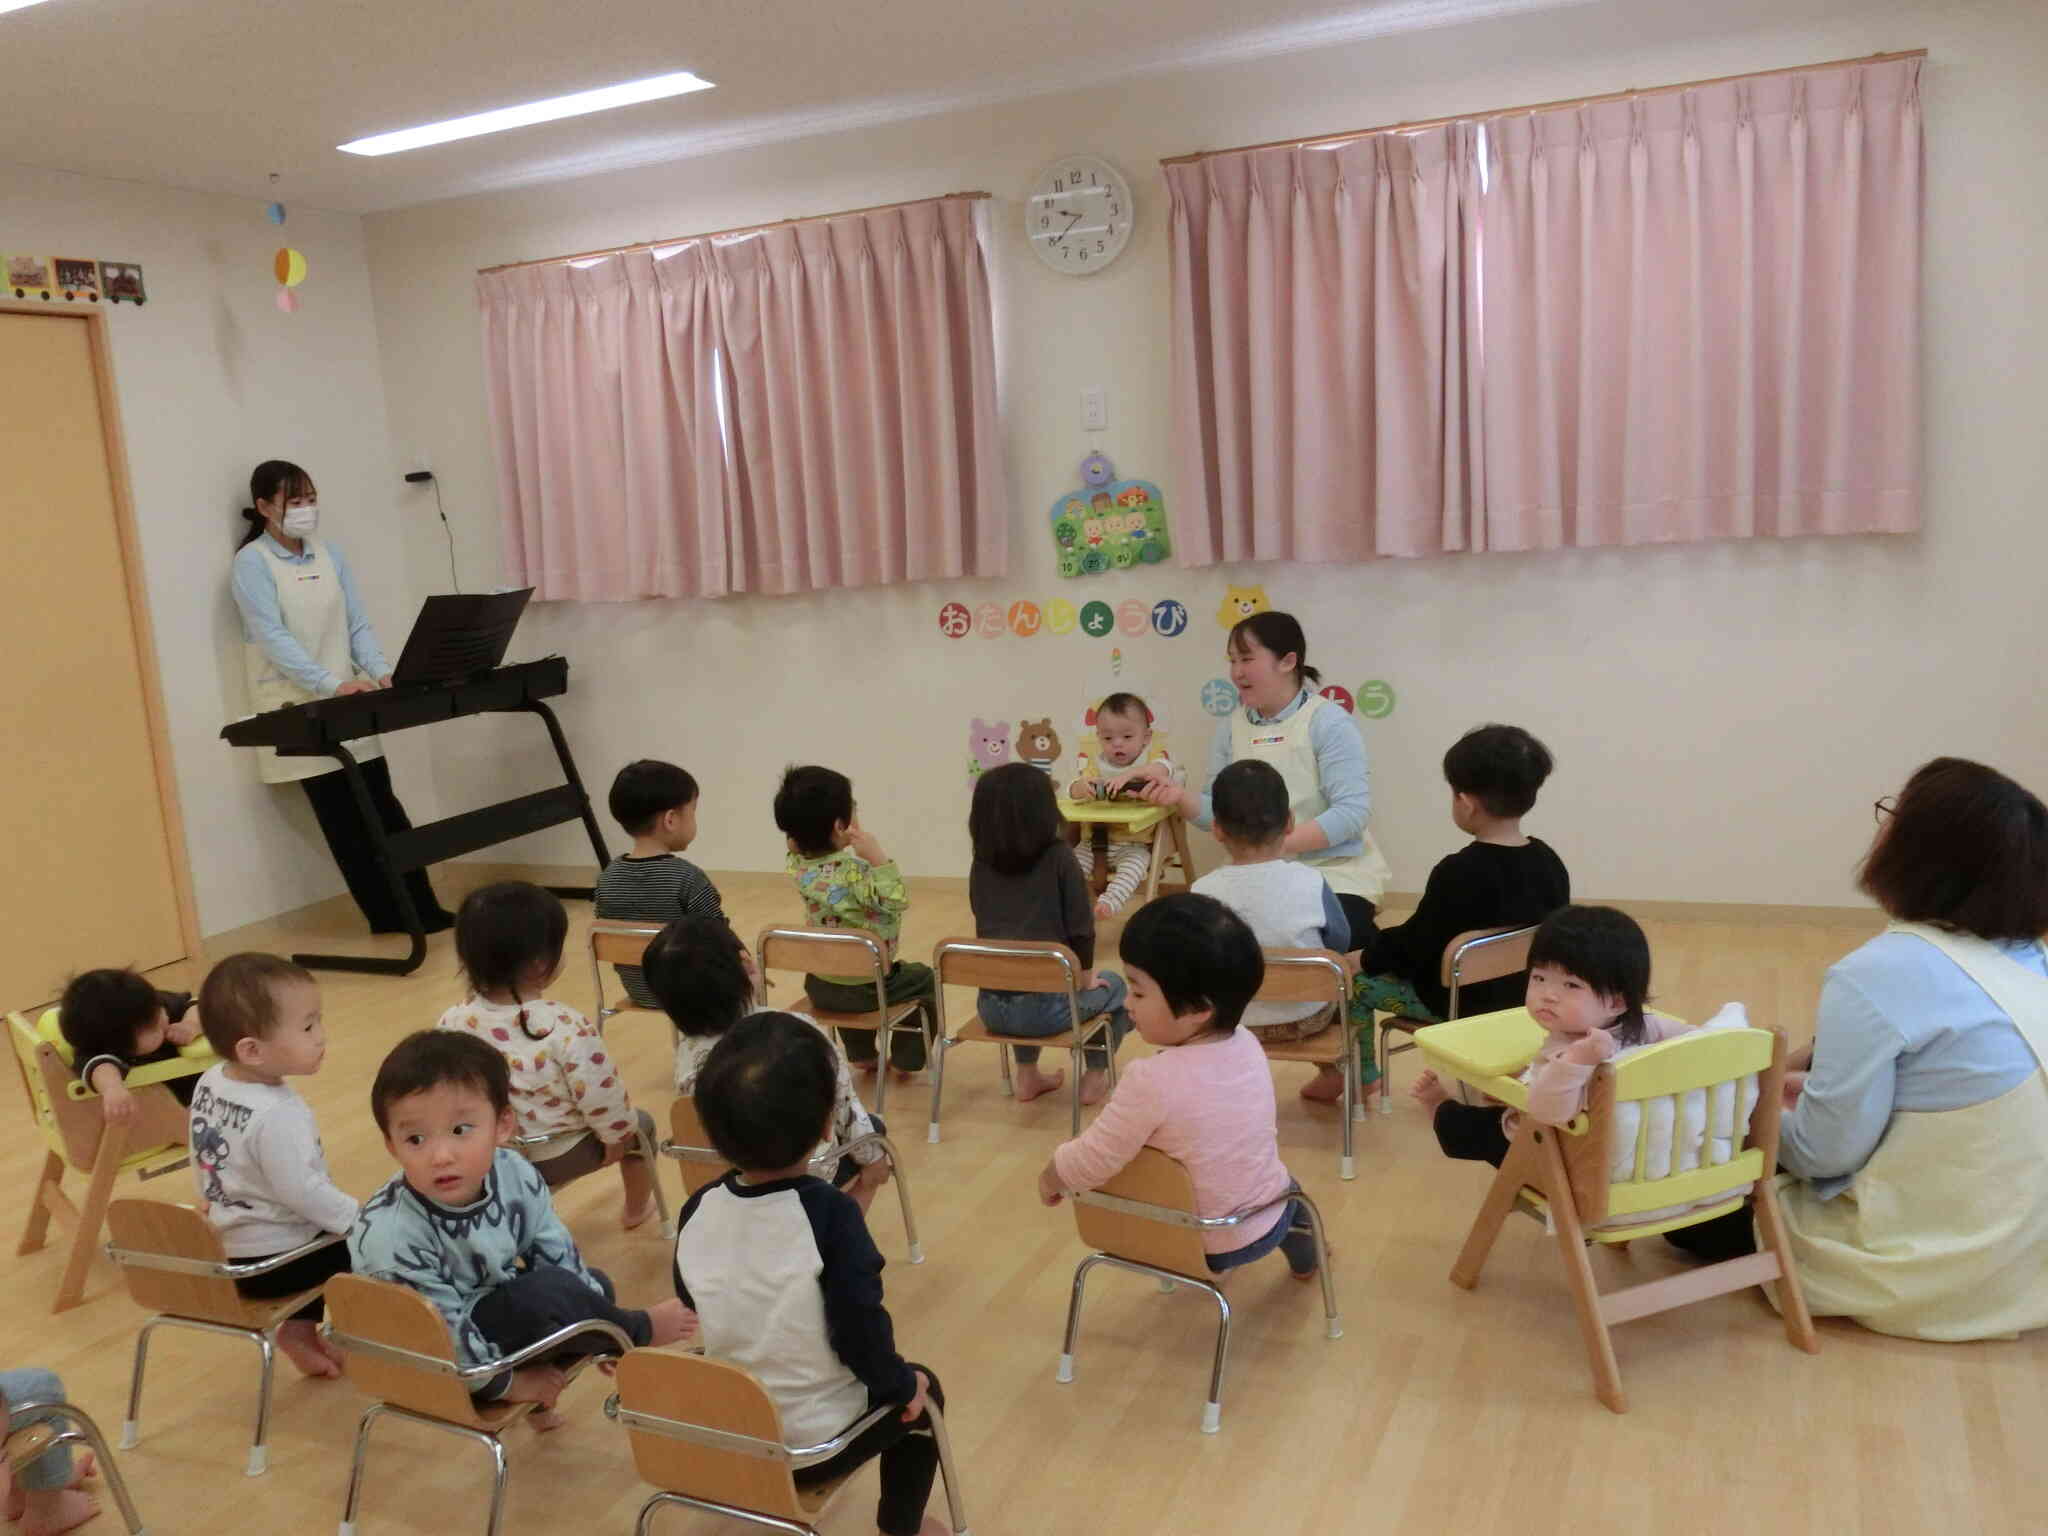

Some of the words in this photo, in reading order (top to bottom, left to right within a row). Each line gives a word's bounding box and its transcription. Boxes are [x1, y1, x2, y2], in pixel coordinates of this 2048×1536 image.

[1070, 171, 1082, 184] 12
[1055, 179, 1063, 193] 11
[1104, 184, 1112, 198] 2
[1110, 203, 1119, 217] 3
[1040, 216, 1050, 229] 9
[1105, 223, 1113, 236] 4
[1061, 246, 1070, 259] 7
[1096, 240, 1104, 254] 5
[1079, 248, 1088, 261] 6
[1063, 562, 1073, 572] 10
[941, 600, 1187, 637] おたんじょうび
[1202, 681, 1236, 714] お
